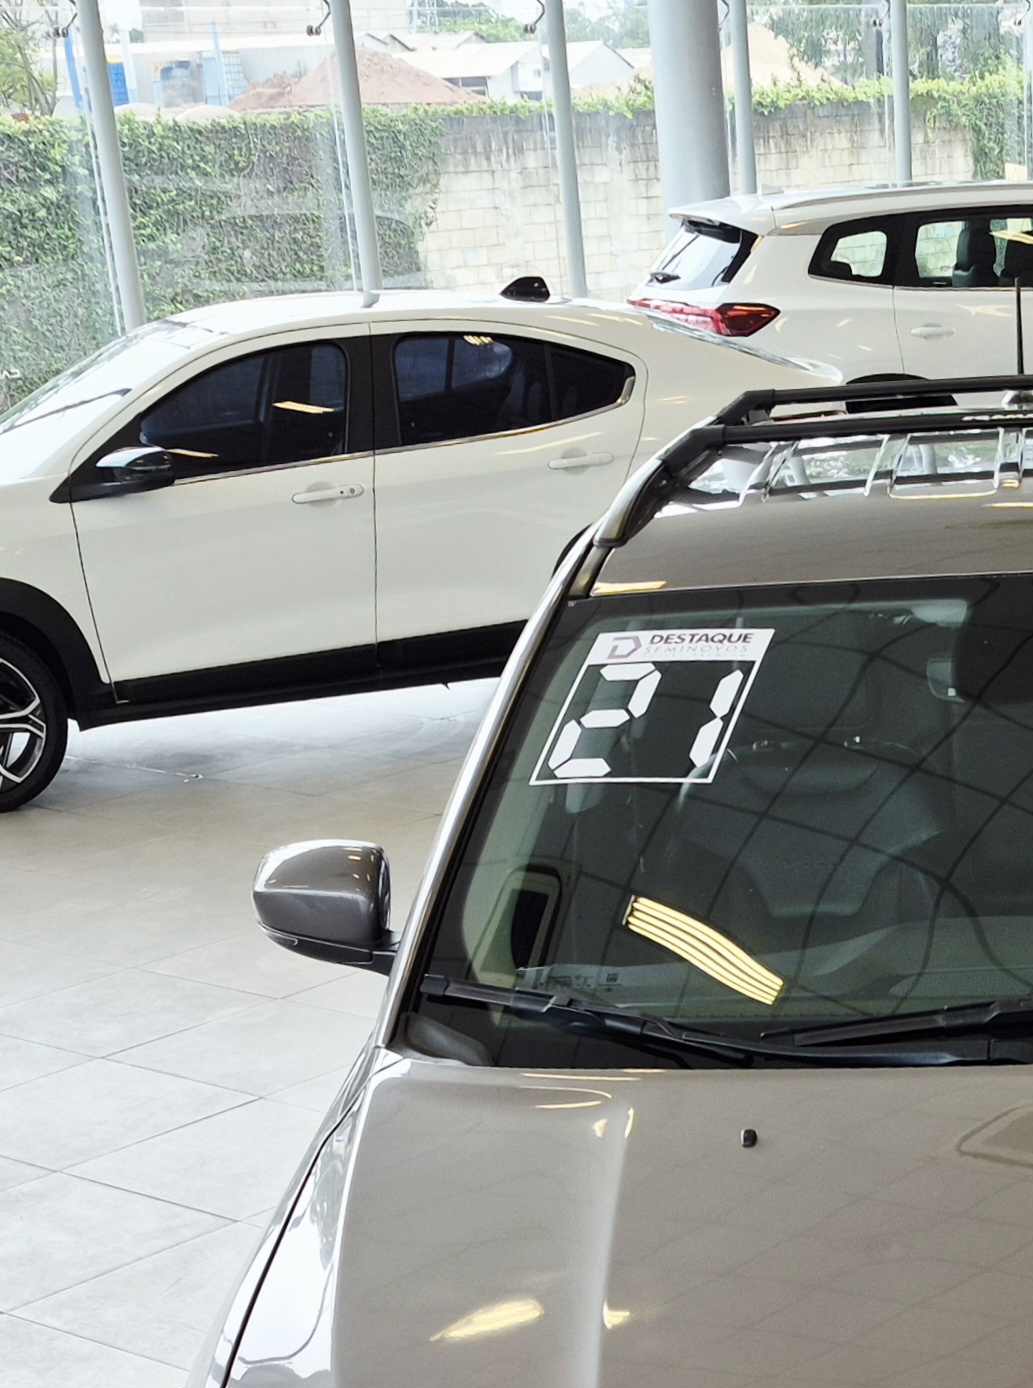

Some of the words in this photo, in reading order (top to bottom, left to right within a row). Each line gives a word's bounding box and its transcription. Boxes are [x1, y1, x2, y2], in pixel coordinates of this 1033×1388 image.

[649, 632, 755, 645] DESTAQUE
[643, 644, 749, 655] SEMINOVOS
[548, 662, 745, 778] 21
